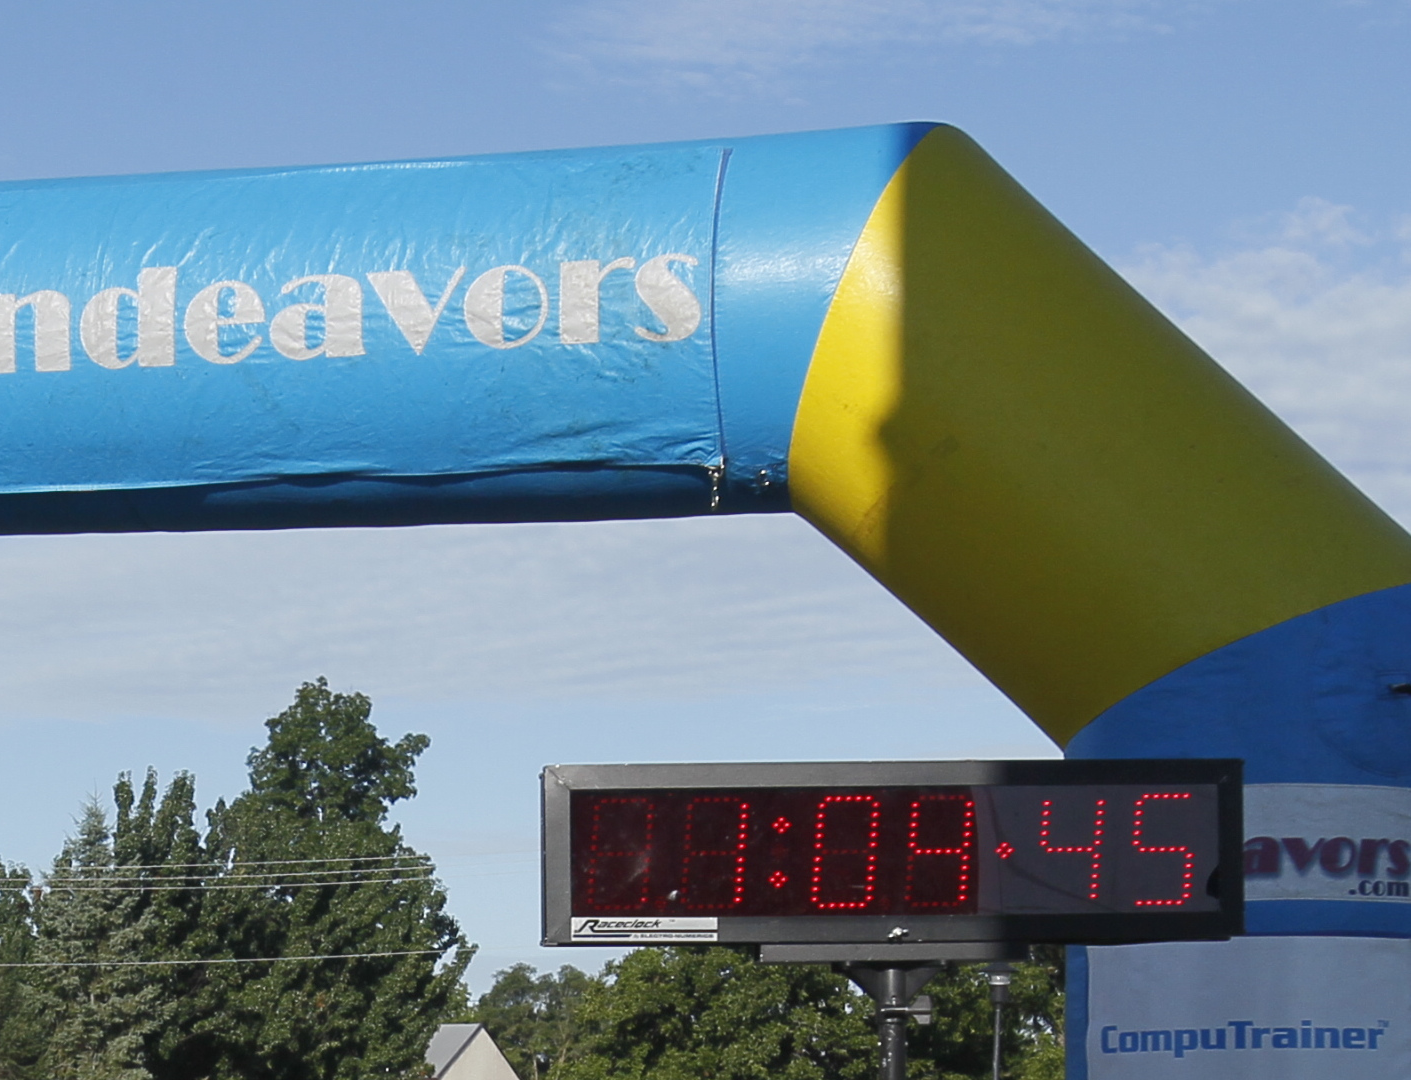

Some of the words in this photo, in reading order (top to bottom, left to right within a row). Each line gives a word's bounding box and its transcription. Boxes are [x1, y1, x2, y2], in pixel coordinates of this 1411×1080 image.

[1244, 836, 1411, 876] avors
[1348, 880, 1410, 896] .com
[574, 919, 662, 933] Raceclock
